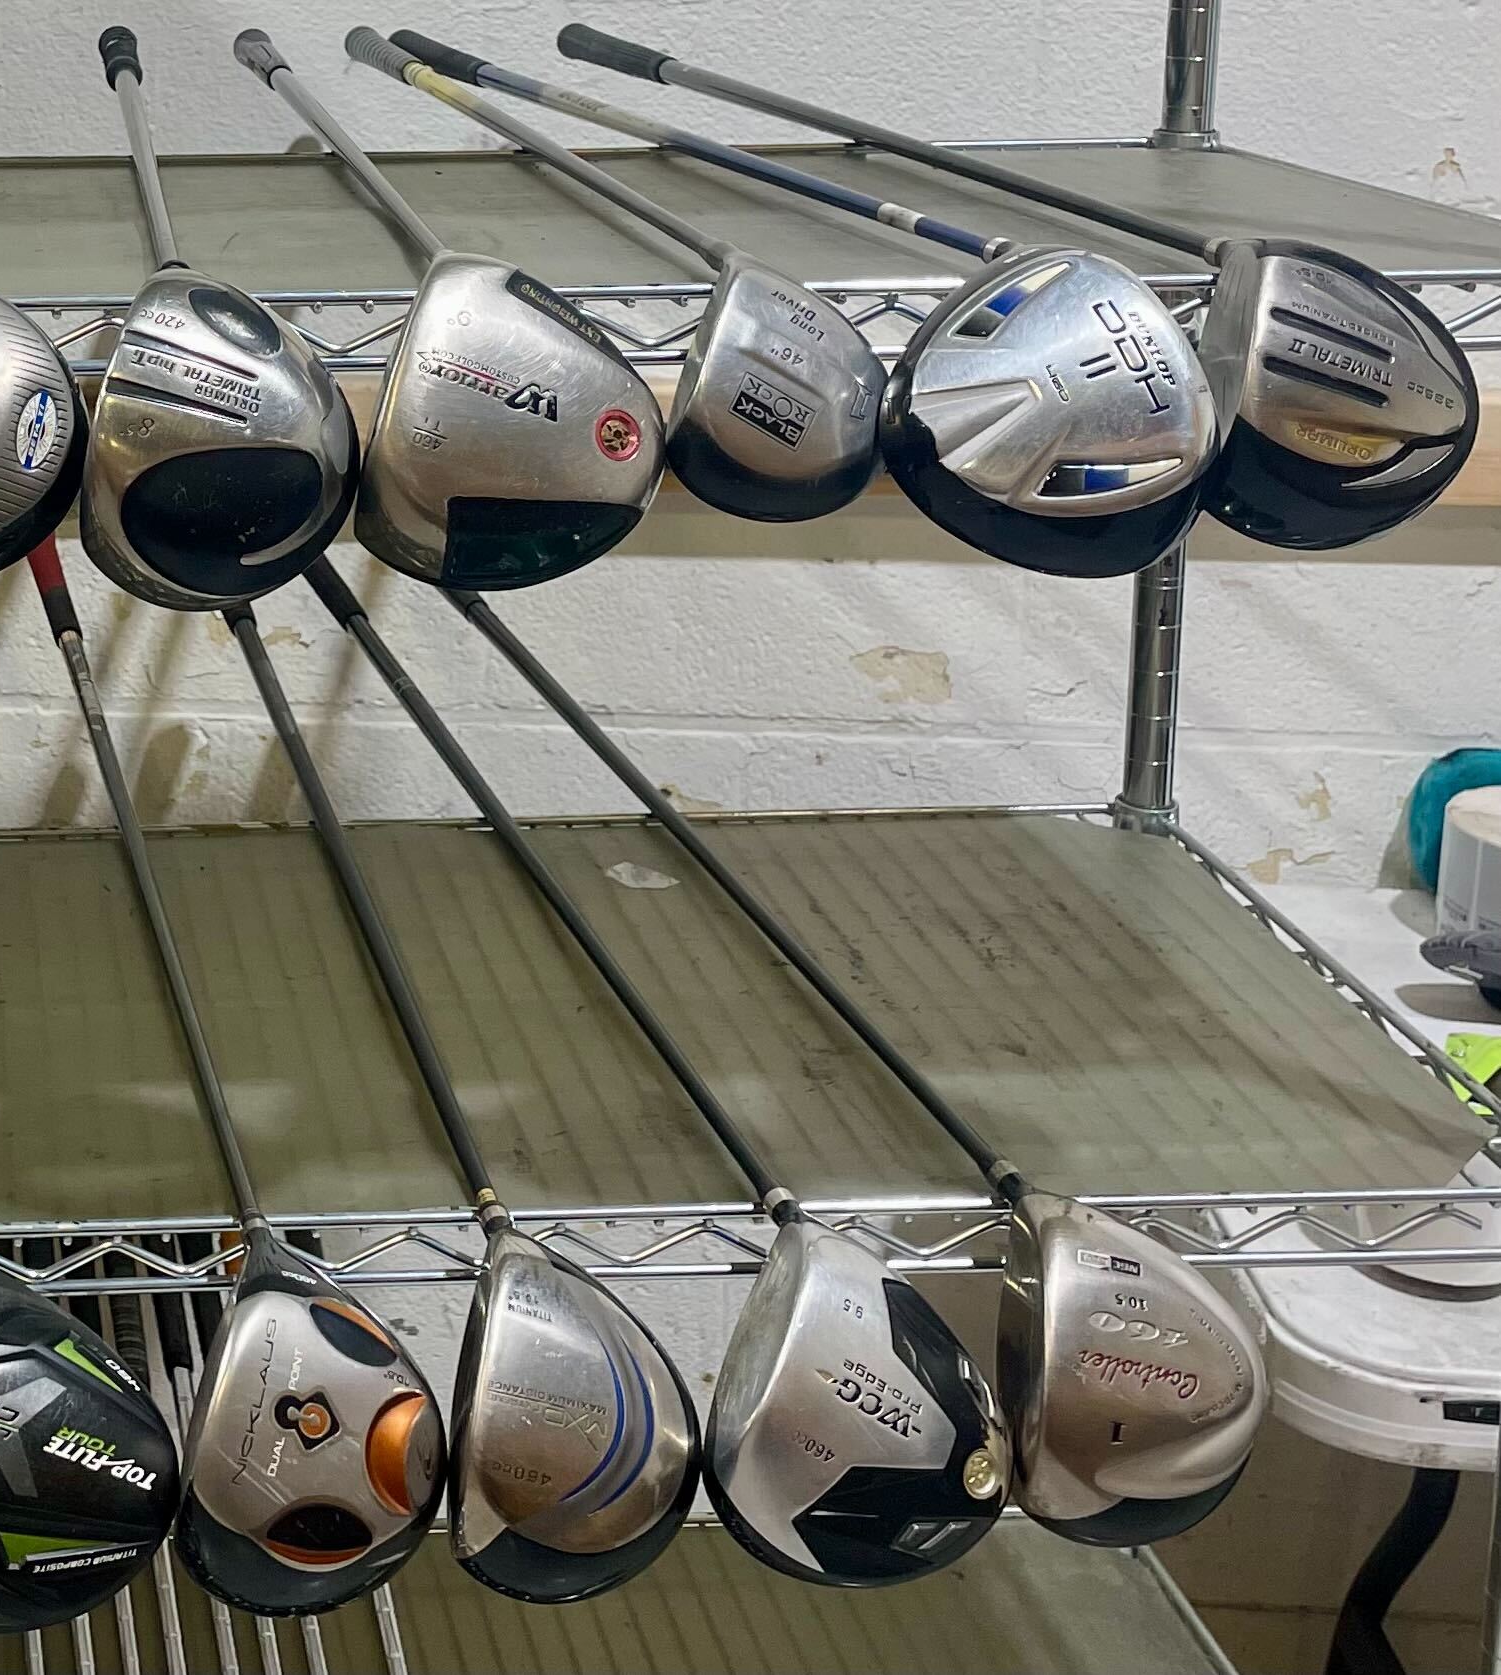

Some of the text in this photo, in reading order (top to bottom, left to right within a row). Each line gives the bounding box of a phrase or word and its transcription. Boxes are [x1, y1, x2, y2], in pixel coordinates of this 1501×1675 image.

[771, 289, 817, 322] Driver
[789, 313, 826, 342] Long
[181, 364, 262, 401] TRIMETAL
[1312, 343, 1393, 388] TRIMETAL
[193, 381, 261, 416] ORLIMAR
[429, 367, 559, 423] Warrior
[745, 378, 811, 423] ROCK
[736, 397, 802, 442] BLACK
[842, 1358, 924, 1415] Pro-Edge
[1077, 1349, 1200, 1400] Controller
[231, 1318, 277, 1487] NICKLAUS
[267, 1347, 305, 1478] DUAL POINT
[55, 1426, 117, 1458] TOUR
